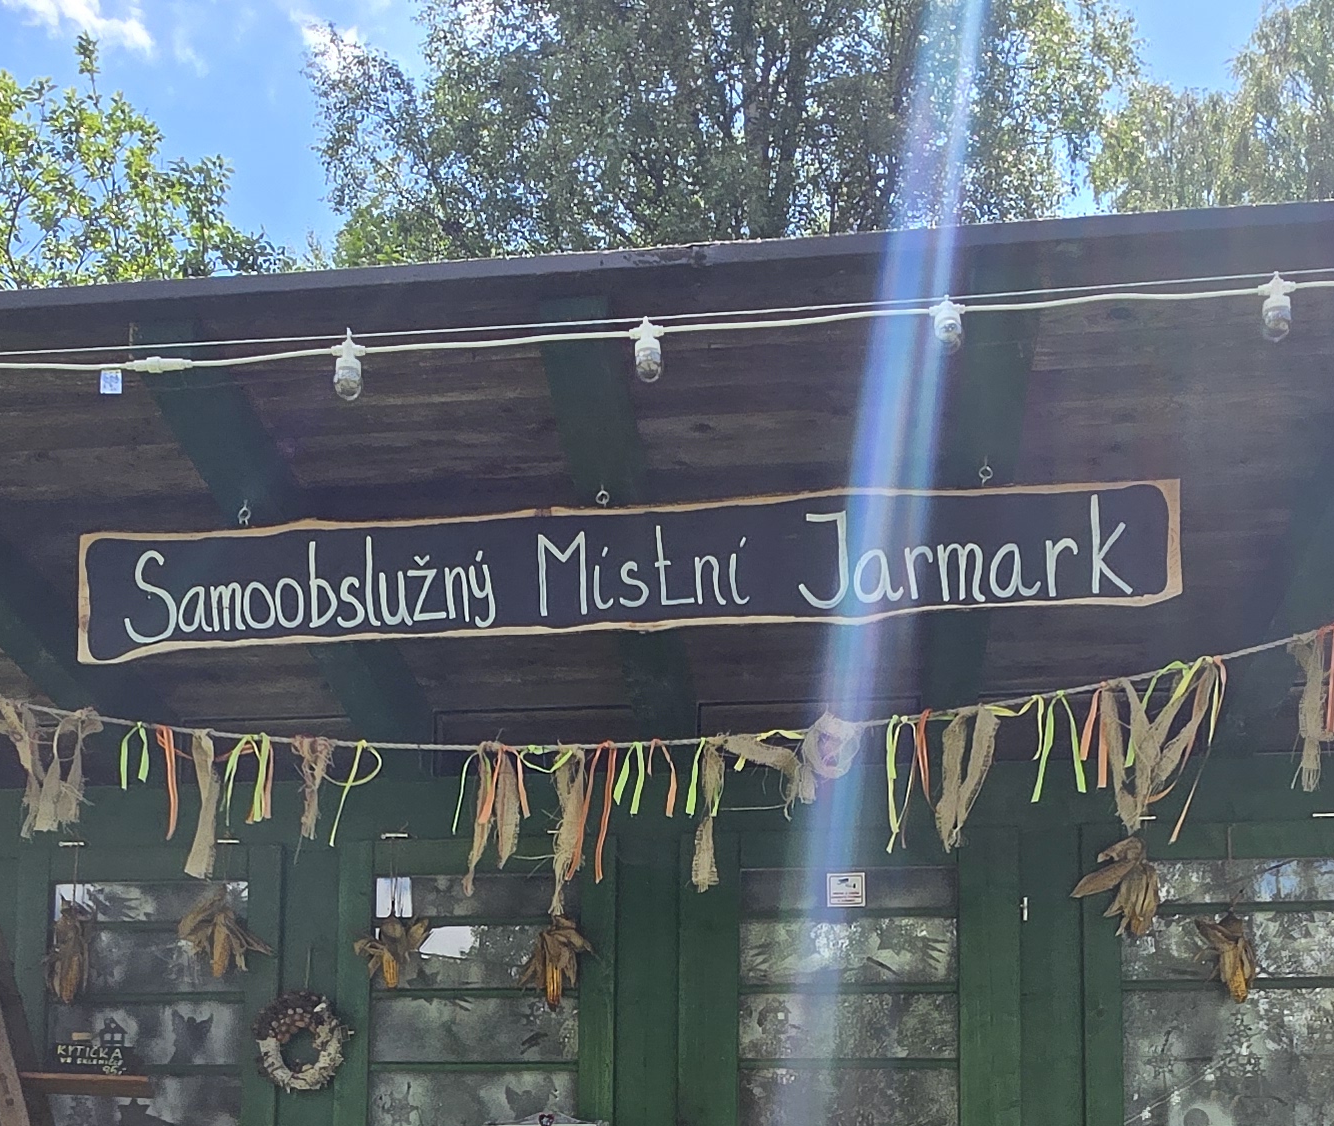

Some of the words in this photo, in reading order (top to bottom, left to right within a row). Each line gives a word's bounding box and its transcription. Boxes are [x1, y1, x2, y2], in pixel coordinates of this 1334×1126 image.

[123, 533, 497, 644] Samoobslužný
[536, 524, 750, 618] Místní
[797, 493, 1134, 610] Jarmark
[57, 1044, 123, 1060] KYTIČKA
